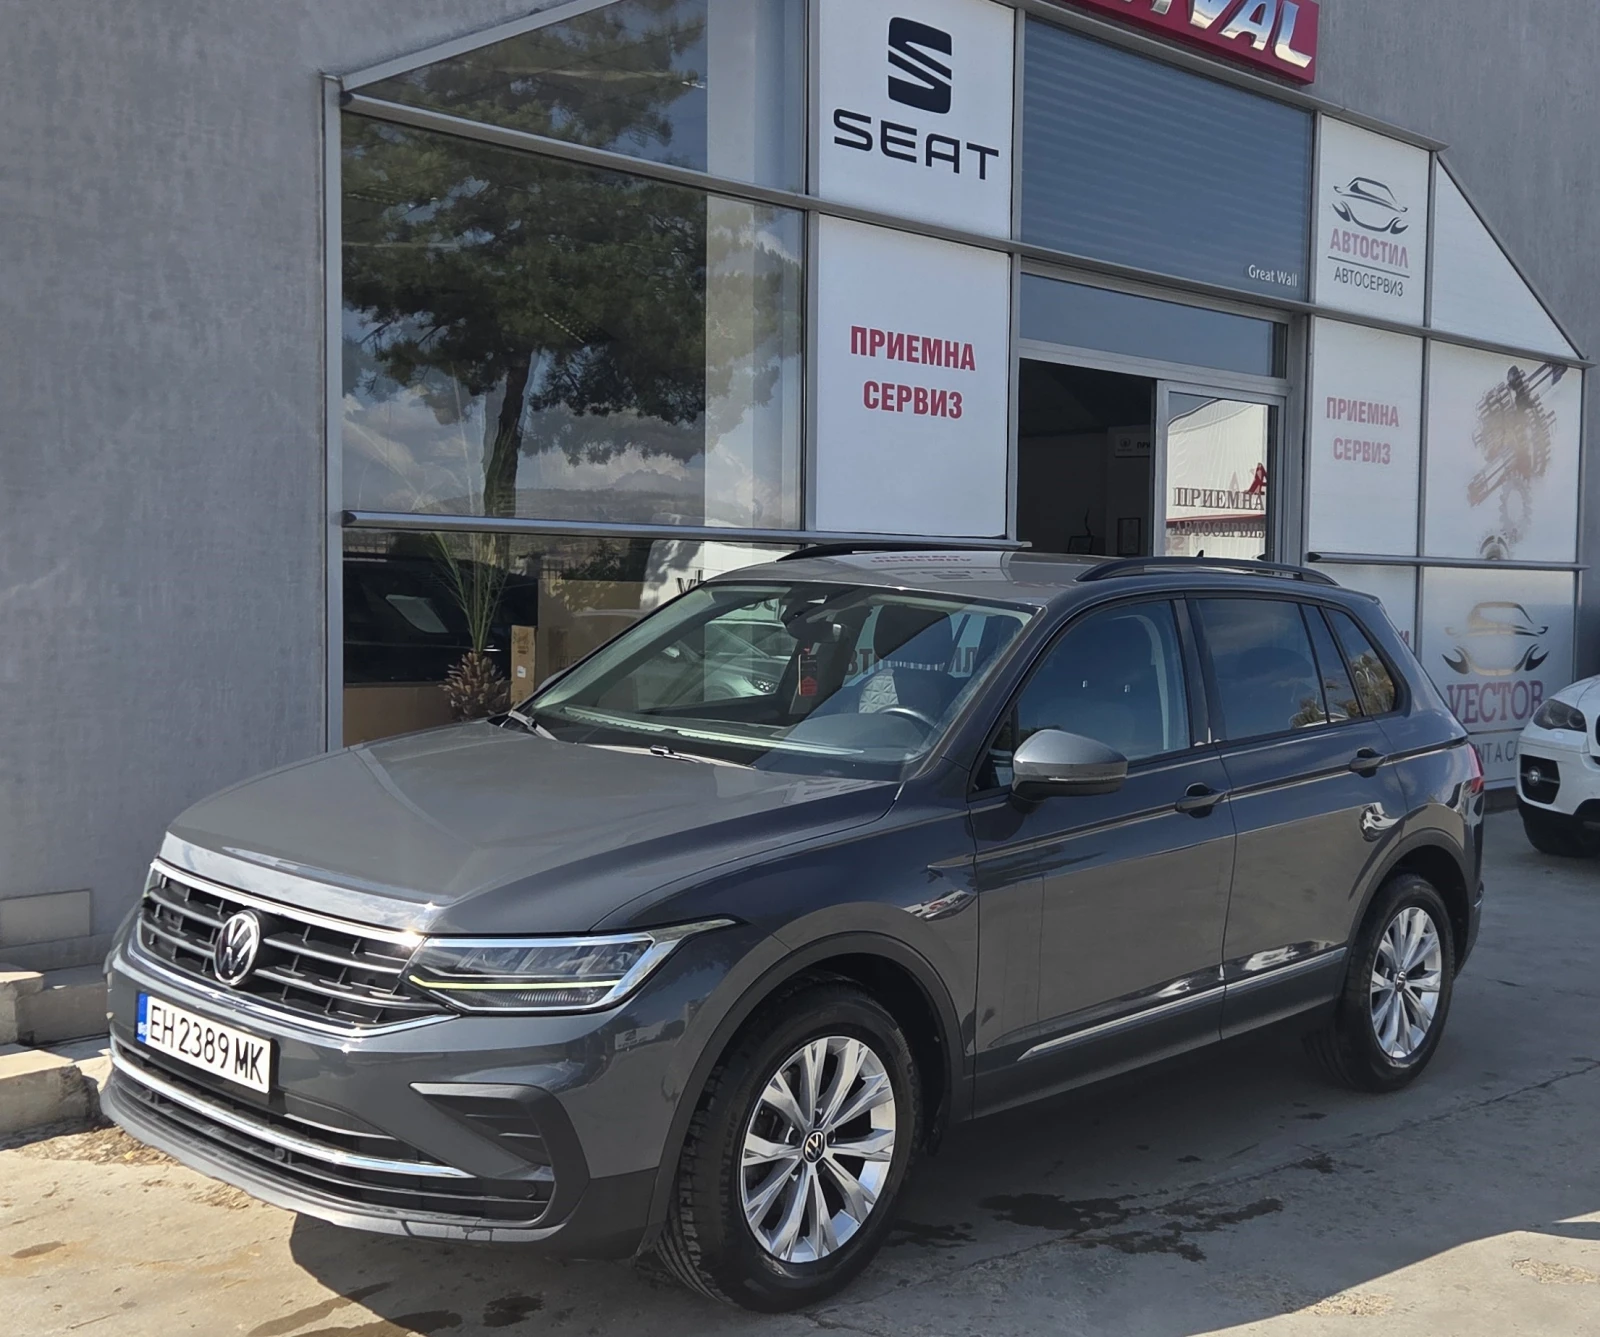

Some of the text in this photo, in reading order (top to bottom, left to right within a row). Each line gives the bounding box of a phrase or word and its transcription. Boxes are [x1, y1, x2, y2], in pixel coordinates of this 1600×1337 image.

[1126, 0, 1312, 68] VAL
[833, 108, 999, 180] SEAT
[1330, 228, 1408, 269] АВТОСТИЛ
[1248, 264, 1298, 287] Great Wall
[1334, 266, 1403, 297] АВТОСЕРВИЗ
[851, 325, 976, 371] ПРИЕМНА
[863, 380, 963, 419] СЕРВИЗ
[1326, 396, 1399, 427] ПРИЕМНА
[1333, 437, 1391, 465] СЕРВИЗ
[1173, 487, 1265, 511] ПРИЕМНА
[1446, 680, 1543, 724] VECTOR
